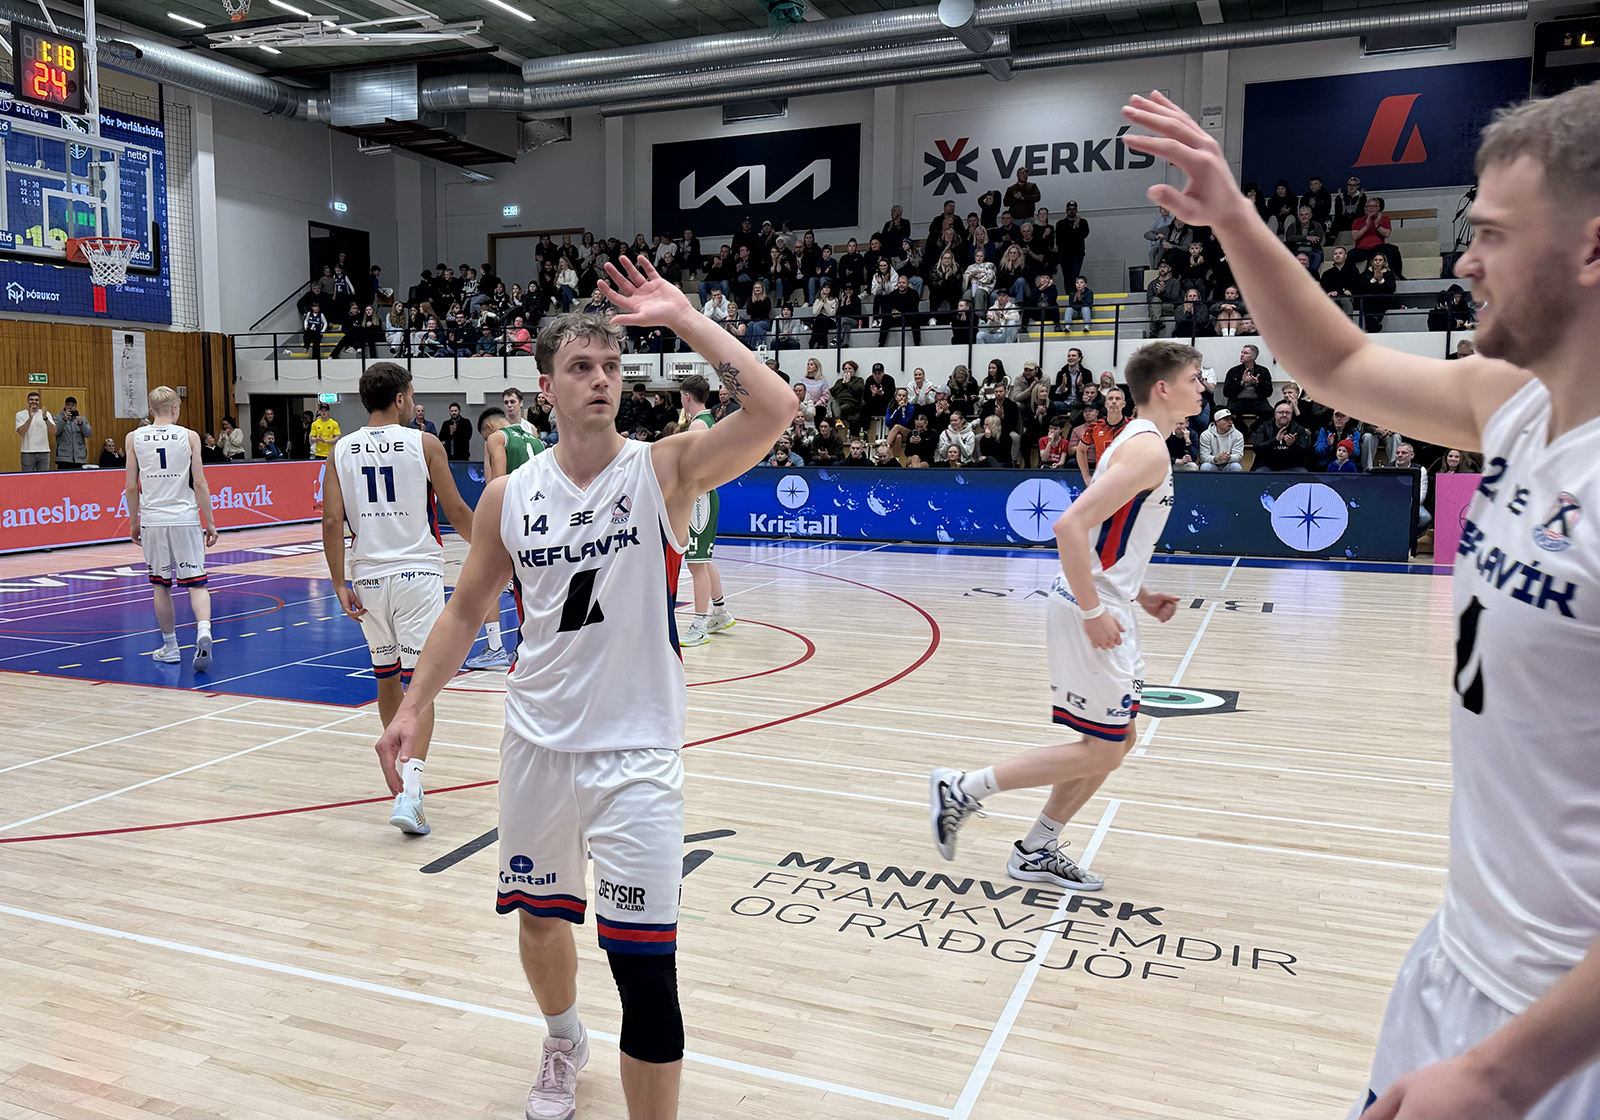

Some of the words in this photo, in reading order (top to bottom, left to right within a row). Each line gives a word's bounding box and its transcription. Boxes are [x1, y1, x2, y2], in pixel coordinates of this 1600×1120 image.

[42, 41, 75, 71] 1:18
[34, 61, 68, 99] 24
[991, 125, 1155, 180] VERKÍS
[679, 158, 831, 210] KIA
[143, 434, 179, 442] BLUE
[351, 441, 404, 454] BLUE
[156, 447, 167, 469] 1
[361, 466, 396, 503] 11
[0, 497, 101, 529] anesbæ
[210, 484, 273, 510] eflavík
[523, 514, 549, 536] 14
[750, 512, 838, 535] Kristall
[517, 526, 641, 568] KEFLAVÍK
[499, 871, 557, 886] Kristall
[598, 879, 646, 905] GEYSIR
[777, 851, 1164, 926] MANNVERK
[730, 896, 818, 925] OG
[838, 912, 1187, 981] RÁÐGJÖF
[752, 872, 1299, 976] FRAMKVÆMDIR
